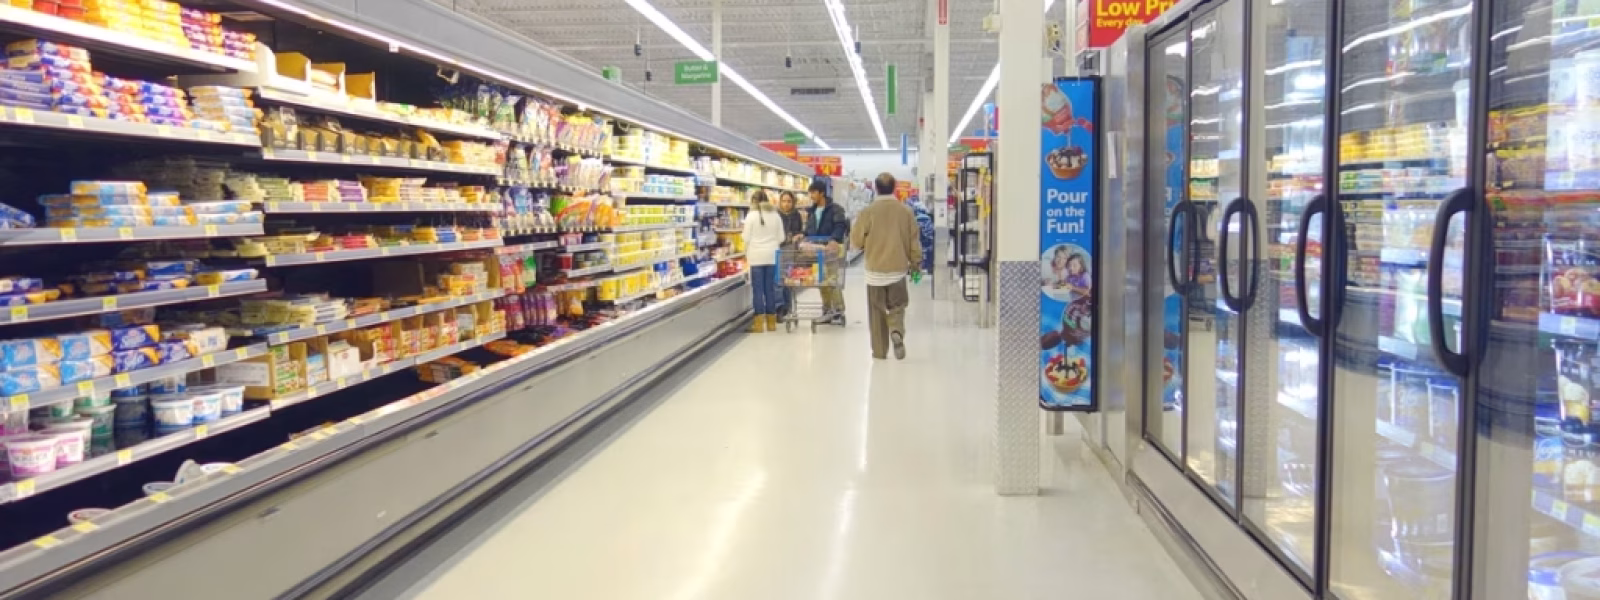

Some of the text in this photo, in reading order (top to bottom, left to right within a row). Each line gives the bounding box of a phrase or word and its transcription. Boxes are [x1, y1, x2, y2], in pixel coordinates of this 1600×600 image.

[1097, 0, 1140, 16] Low
[1097, 18, 1124, 28] Every
[1046, 188, 1088, 204] Pour
[1046, 206, 1085, 217] on the
[1046, 218, 1084, 234] Fun!
